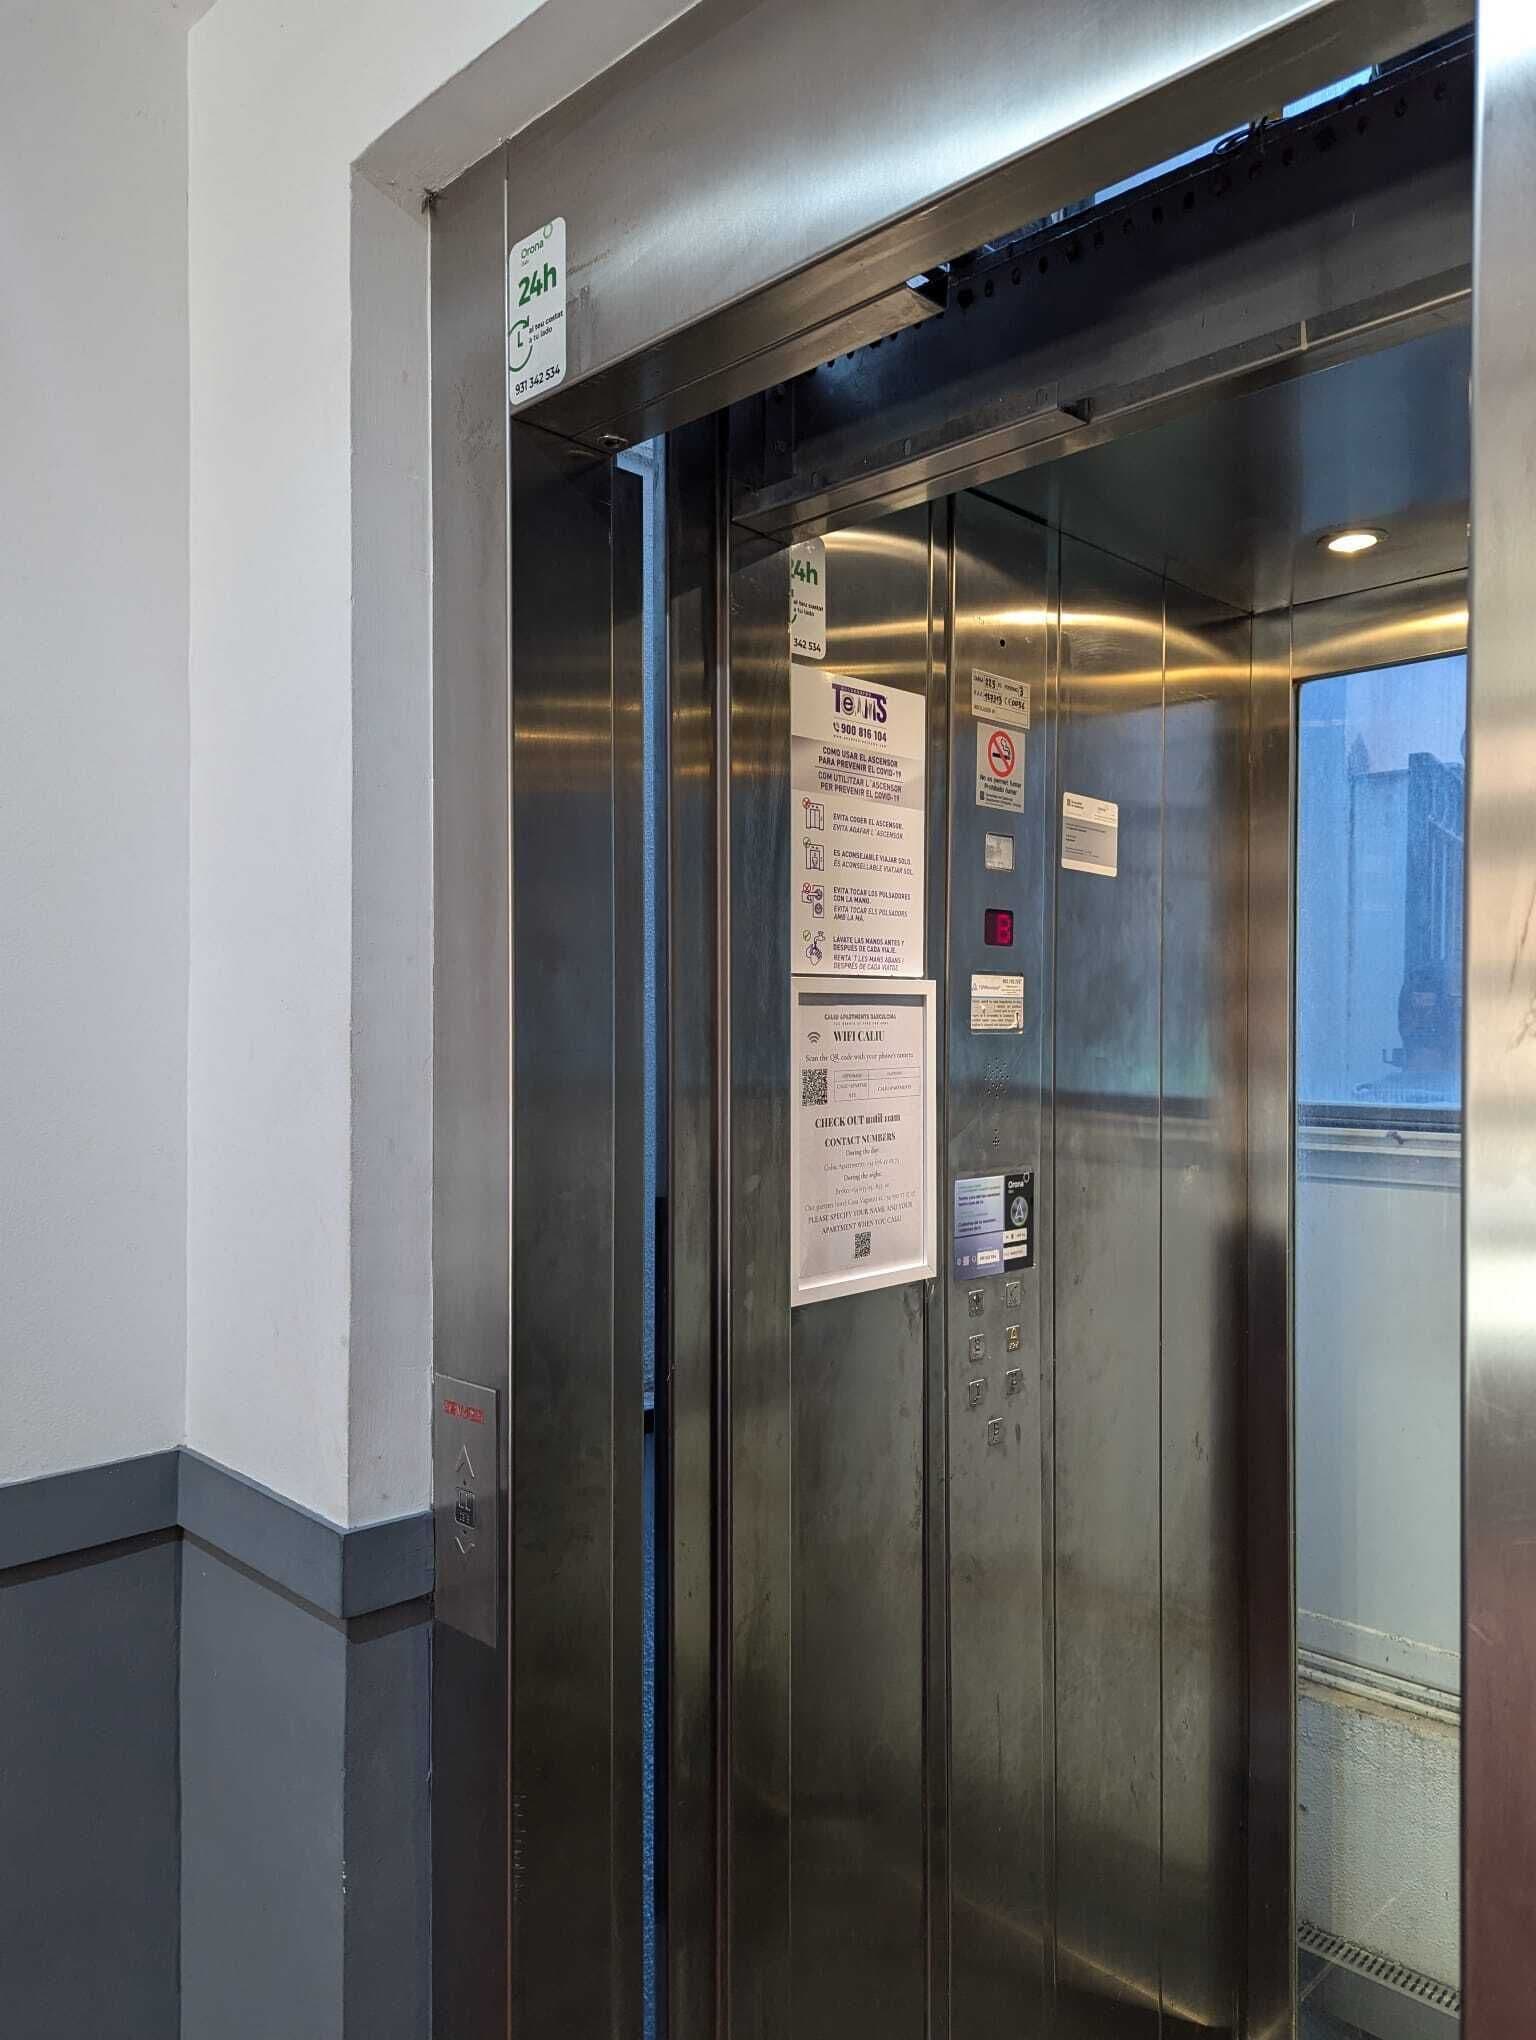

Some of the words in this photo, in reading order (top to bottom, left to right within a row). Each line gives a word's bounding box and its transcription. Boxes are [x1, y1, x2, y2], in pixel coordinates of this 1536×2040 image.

[521, 240, 544, 258] Orona
[519, 262, 557, 307] 24h
[540, 326, 553, 337] lado
[515, 380, 527, 396] 931
[529, 372, 543, 388] 342
[546, 364, 560, 380] 534
[793, 638, 806, 648] 342
[808, 641, 821, 652] 534
[841, 723, 856, 735] 900
[858, 727, 872, 739] 816
[874, 730, 887, 742] 104
[822, 746, 840, 756] COMO
[842, 749, 857, 759] USAR
[860, 753, 867, 761] EL
[868, 754, 897, 768] ASCENSOR
[819, 756, 835, 766] PARA
[837, 759, 867, 772] PREVENIR
[868, 765, 875, 773] EL
[876, 766, 901, 778] COVID-19
[819, 771, 832, 780] COM
[833, 772, 864, 786] UTILITZAR
[872, 780, 902, 792] ASCENSOR
[820, 782, 833, 791] PER
[834, 784, 865, 797] PREVENIR
[866, 789, 873, 797] EL
[833, 813, 848, 822] EVITA
[850, 816, 867, 824] COGER
[833, 824, 848, 832] EVITA
[841, 850, 880, 861] ACONSEJABLE
[880, 855, 897, 863] VIAJAR
[842, 861, 882, 872] ACONSELLABLE
[850, 887, 867, 896] TOCAR
[868, 889, 878, 897] LOS
[879, 890, 911, 901] PULSADORES
[833, 905, 848, 913] EVITA
[850, 906, 867, 914] TOCAR
[879, 909, 908, 917] PULSADORS
[865, 937, 883, 945] MANOS
[884, 938, 900, 946] ANTES
[867, 945, 880, 953] CADA
[833, 1030, 855, 1042] WIFI
[858, 1030, 885, 1041] CALIU
[815, 1117, 846, 1128] CHECK
[847, 1115, 864, 1126] OUT
[866, 1112, 882, 1124] until
[825, 1136, 860, 1147] CONTACT
[862, 1132, 896, 1144] NUMBERS
[808, 1214, 828, 1224] PLEASE
[821, 1223, 856, 1234] APARTMENT
